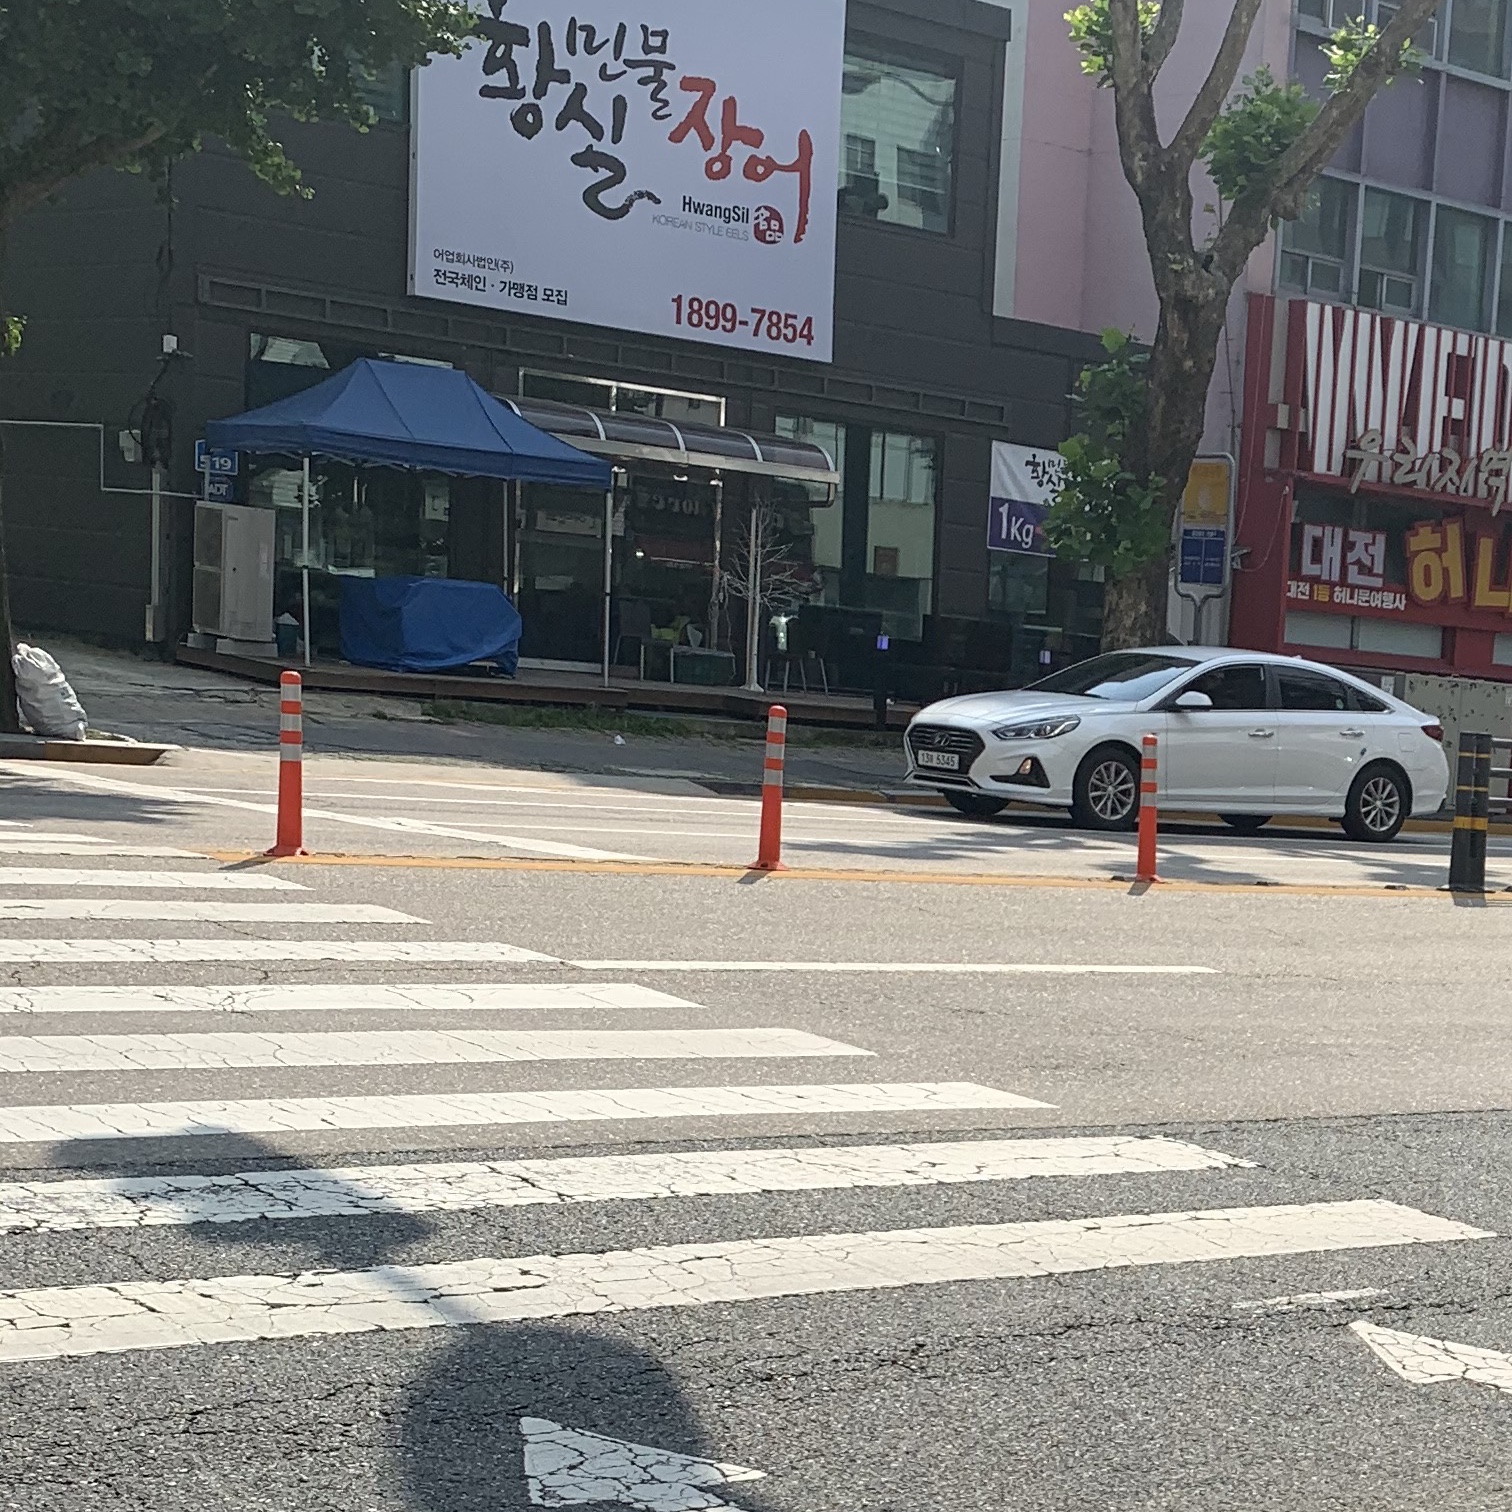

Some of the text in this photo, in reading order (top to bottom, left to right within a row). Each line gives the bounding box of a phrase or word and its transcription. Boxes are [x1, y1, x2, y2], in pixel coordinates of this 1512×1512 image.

[668, 76, 813, 244] 장어
[652, 213, 749, 242] KOREAN STYLE EELS
[682, 195, 750, 224] HwangSil
[433, 249, 514, 274] 어업회사법인(주)
[433, 268, 568, 307] 전국체인 가맹점 모집
[671, 294, 814, 346] 1899-7854
[999, 503, 1034, 549] 1Kg
[1301, 524, 1388, 588] 대전
